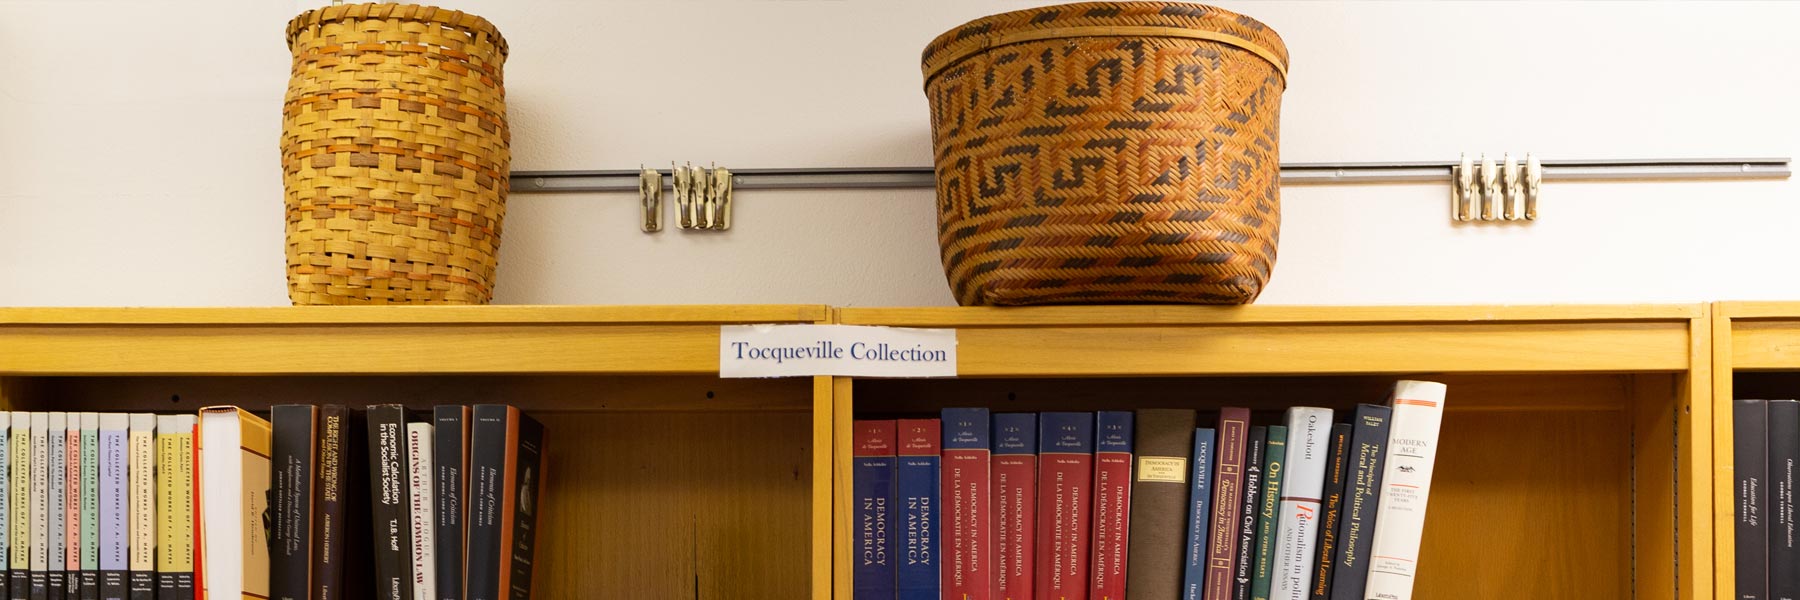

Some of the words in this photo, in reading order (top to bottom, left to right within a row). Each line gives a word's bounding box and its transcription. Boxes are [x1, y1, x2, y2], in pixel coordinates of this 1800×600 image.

[732, 341, 843, 363] Tocqueville
[850, 342, 947, 362] Collection
[389, 424, 398, 459] Economic
[1305, 415, 1317, 460] Oakeshott
[1392, 438, 1427, 448] MODERN
[381, 446, 390, 477] Socialist
[1359, 443, 1369, 468] Moral
[1370, 445, 1379, 457] The
[326, 459, 332, 469] BY
[954, 468, 960, 478] DE
[1197, 441, 1207, 489] TOCQUEVILLE
[1269, 462, 1280, 478] On
[1365, 458, 1376, 488] Principles
[390, 461, 399, 504] Calculation
[413, 476, 420, 490] OF
[488, 468, 496, 492] Elements
[955, 480, 960, 489] LA
[1000, 474, 1006, 483] DE
[1057, 472, 1063, 482] DE
[1101, 471, 1107, 481] DE
[1101, 483, 1107, 491] LA
[1357, 471, 1367, 485] and
[330, 492, 337, 501] OF
[382, 478, 391, 504] Society
[1000, 485, 1006, 494] LA
[1057, 483, 1063, 492] LA
[1218, 480, 1229, 516] Democracy
[1246, 474, 1257, 503] Hobbes
[864, 498, 872, 510] IN
[908, 497, 917, 509] IN
[1115, 486, 1123, 530] DEMOCRACY
[1246, 505, 1252, 513] on
[1262, 481, 1279, 518] History
[1329, 494, 1339, 508] The
[1352, 487, 1365, 520] Political
[1749, 505, 1757, 514] for
[487, 500, 495, 525] Criticism
[1099, 493, 1107, 539] DÉMOCRATIE
[1195, 500, 1203, 533] DEMOCRACY
[1326, 510, 1336, 528] Voice
[1749, 515, 1757, 526] Life
[877, 498, 885, 565] DEMOCRACY
[921, 497, 929, 565] DEMOCRACY
[971, 529, 977, 537] IN
[1244, 516, 1253, 533] Civil
[1295, 504, 1314, 562] Rationalism
[1325, 530, 1335, 538] of
[414, 516, 422, 562] COMMON
[864, 514, 872, 565] AMERICA
[908, 514, 917, 565] AMERICA
[955, 538, 961, 548] EN
[1000, 543, 1006, 552] EN
[1016, 534, 1022, 542] IN
[1055, 541, 1061, 551] EN
[1071, 533, 1077, 541] IN
[1099, 541, 1105, 550] EN
[1115, 533, 1121, 541] IN
[1216, 525, 1225, 554] America
[1344, 522, 1360, 567] Philosophy
[1239, 535, 1250, 577] Association
[1284, 543, 1292, 566] OTHER
[1321, 538, 1333, 563] Liberal
[955, 550, 963, 586] AMÉRIQUE
[999, 554, 1007, 591] AMÉRIQUE
[1053, 553, 1062, 590] AMÉRIQUE
[1097, 552, 1106, 589] AMÉRIQUE
[1294, 565, 1303, 574] in
[1316, 565, 1330, 596] Learning
